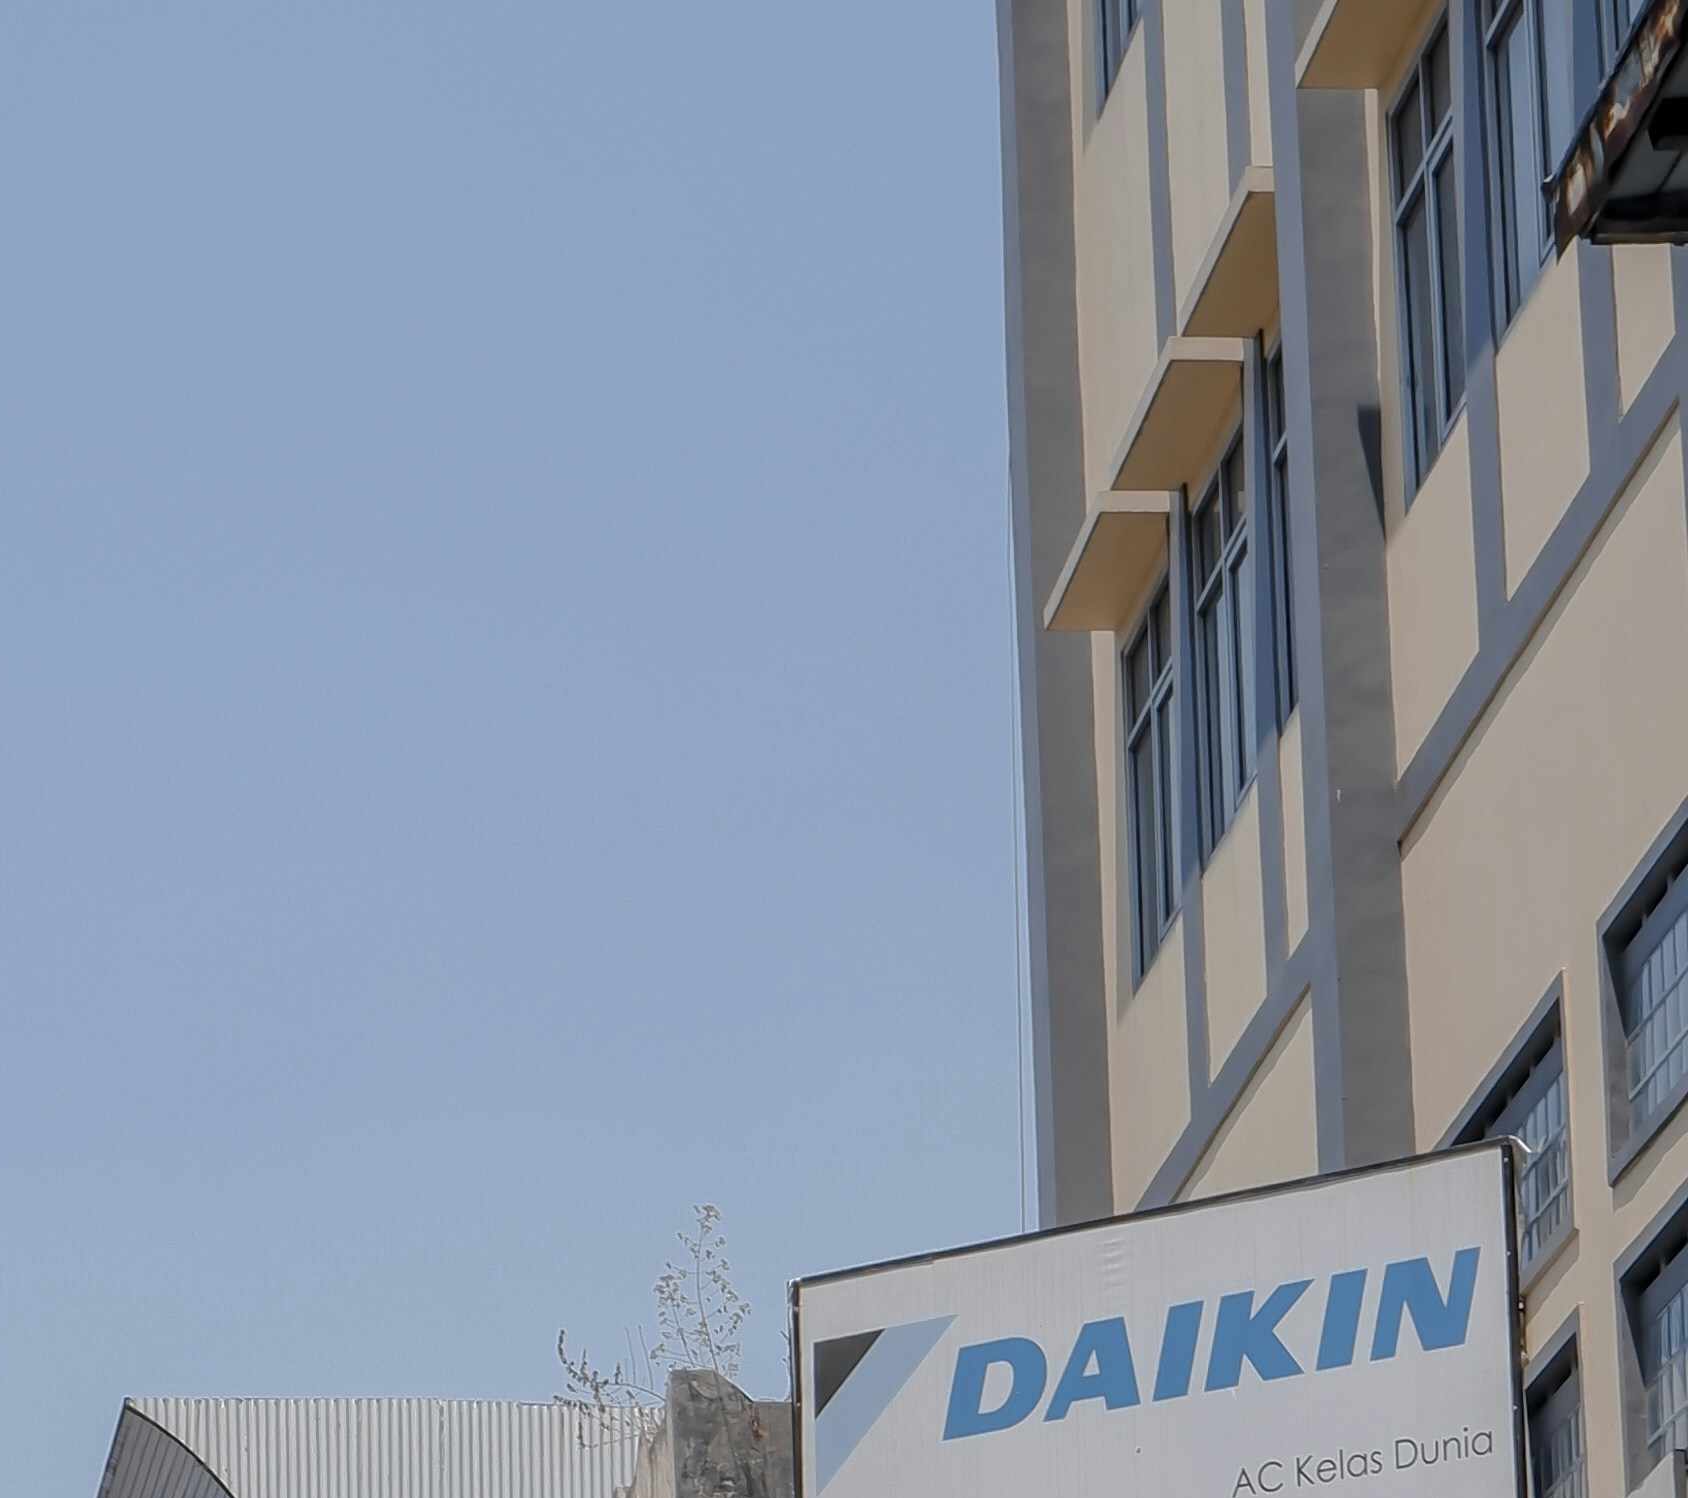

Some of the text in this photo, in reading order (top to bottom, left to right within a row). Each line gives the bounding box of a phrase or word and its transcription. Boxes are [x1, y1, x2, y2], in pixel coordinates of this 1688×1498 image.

[942, 1245, 1481, 1442] DAIKIN
[1231, 1426, 1494, 1498] AC Kelas Dunia
